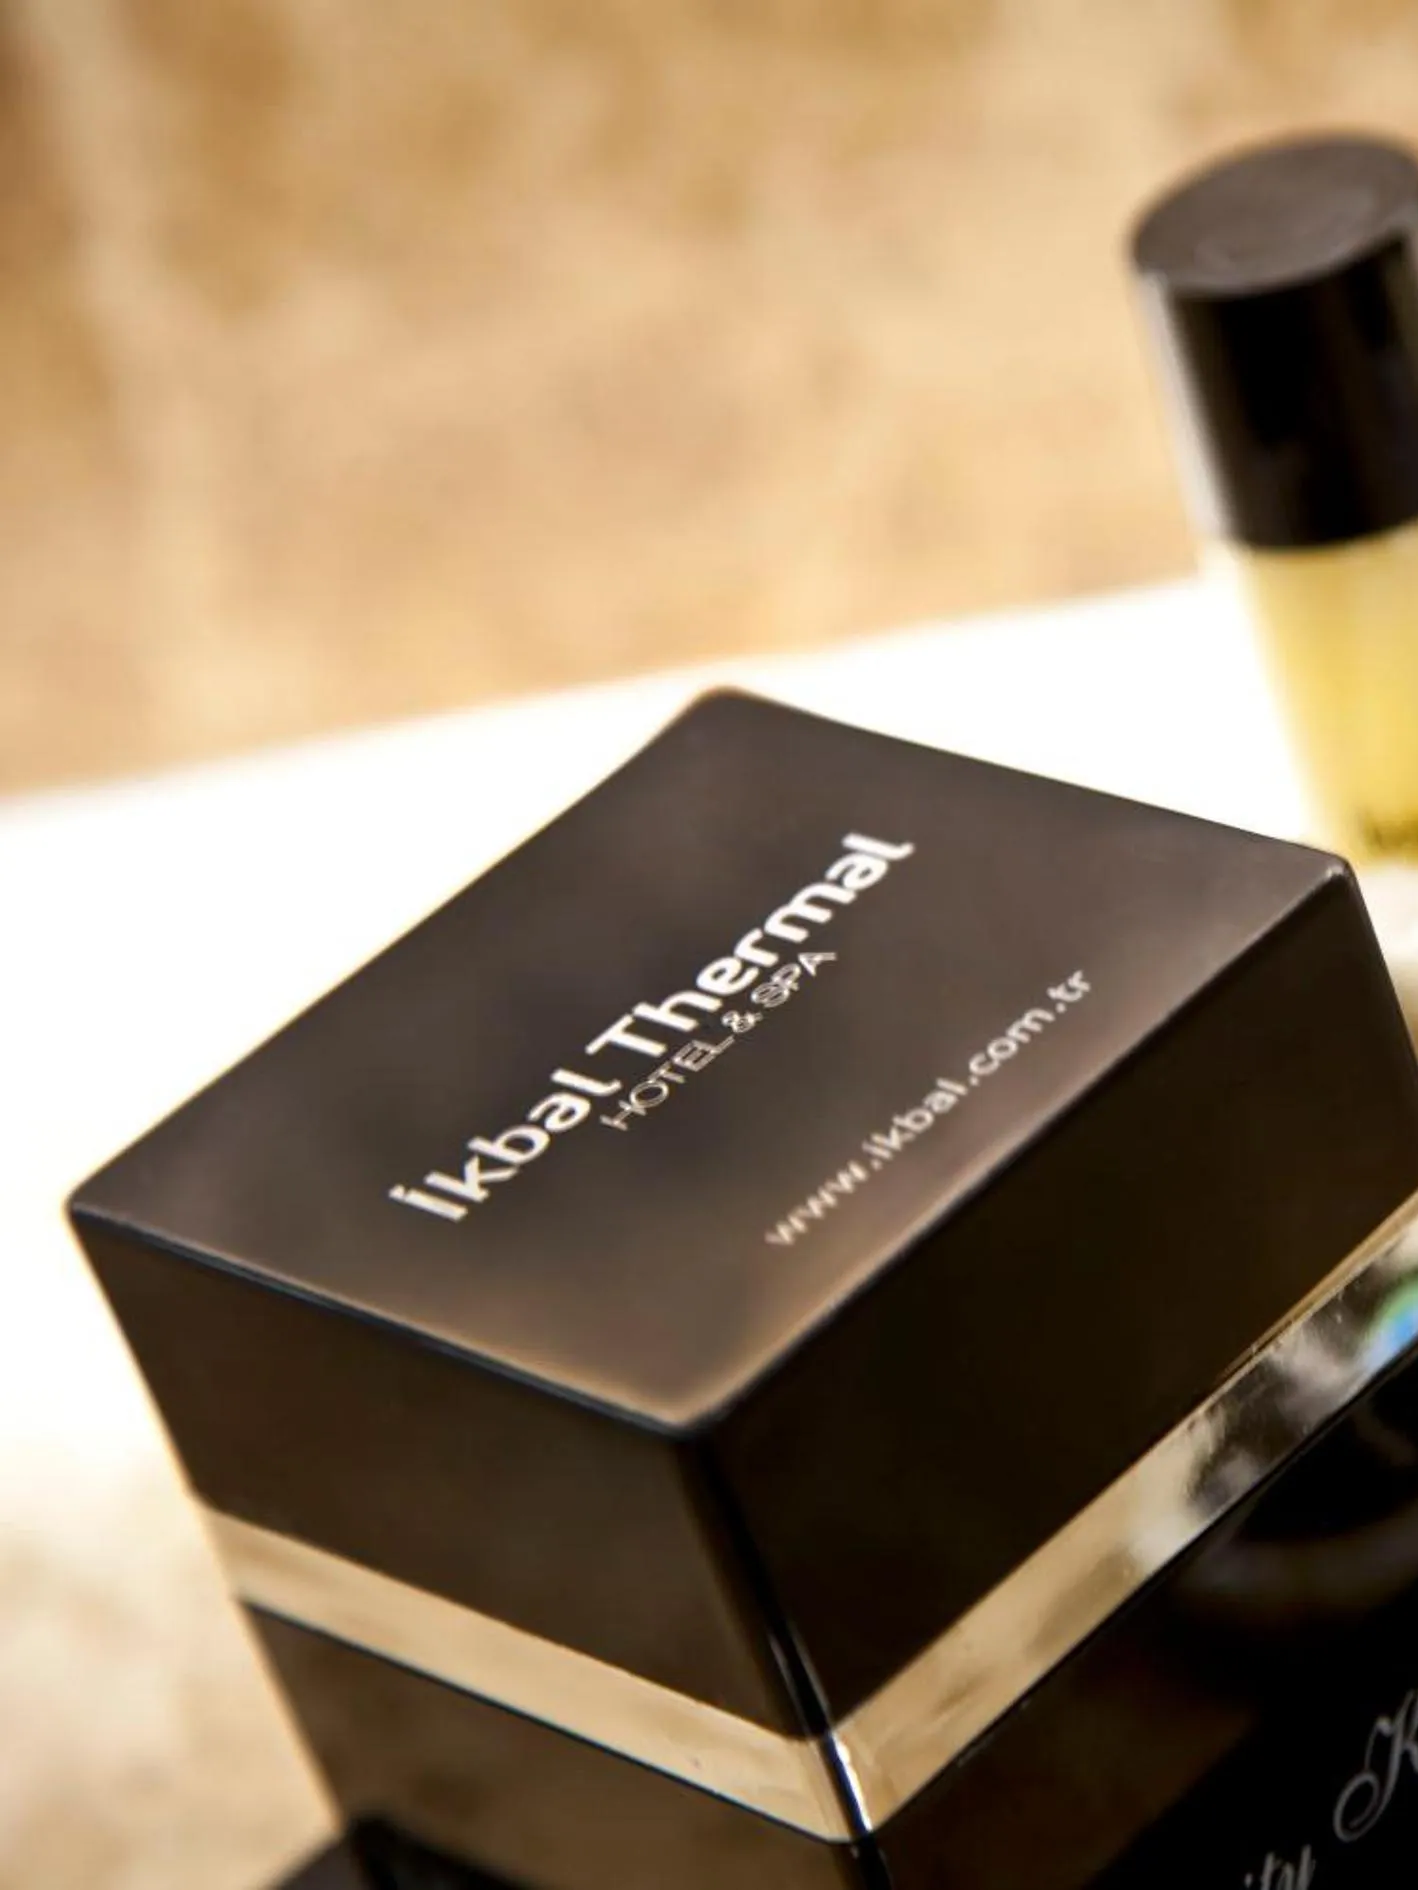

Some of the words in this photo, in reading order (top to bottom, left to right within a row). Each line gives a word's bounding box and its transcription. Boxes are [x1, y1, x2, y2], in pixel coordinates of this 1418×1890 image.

[586, 833, 914, 1057] Thermal
[600, 1034, 736, 1131] HOTEL
[720, 1009, 764, 1034] &
[751, 952, 837, 1009] SPA
[764, 970, 1092, 1246] www.ikbal.com.tr
